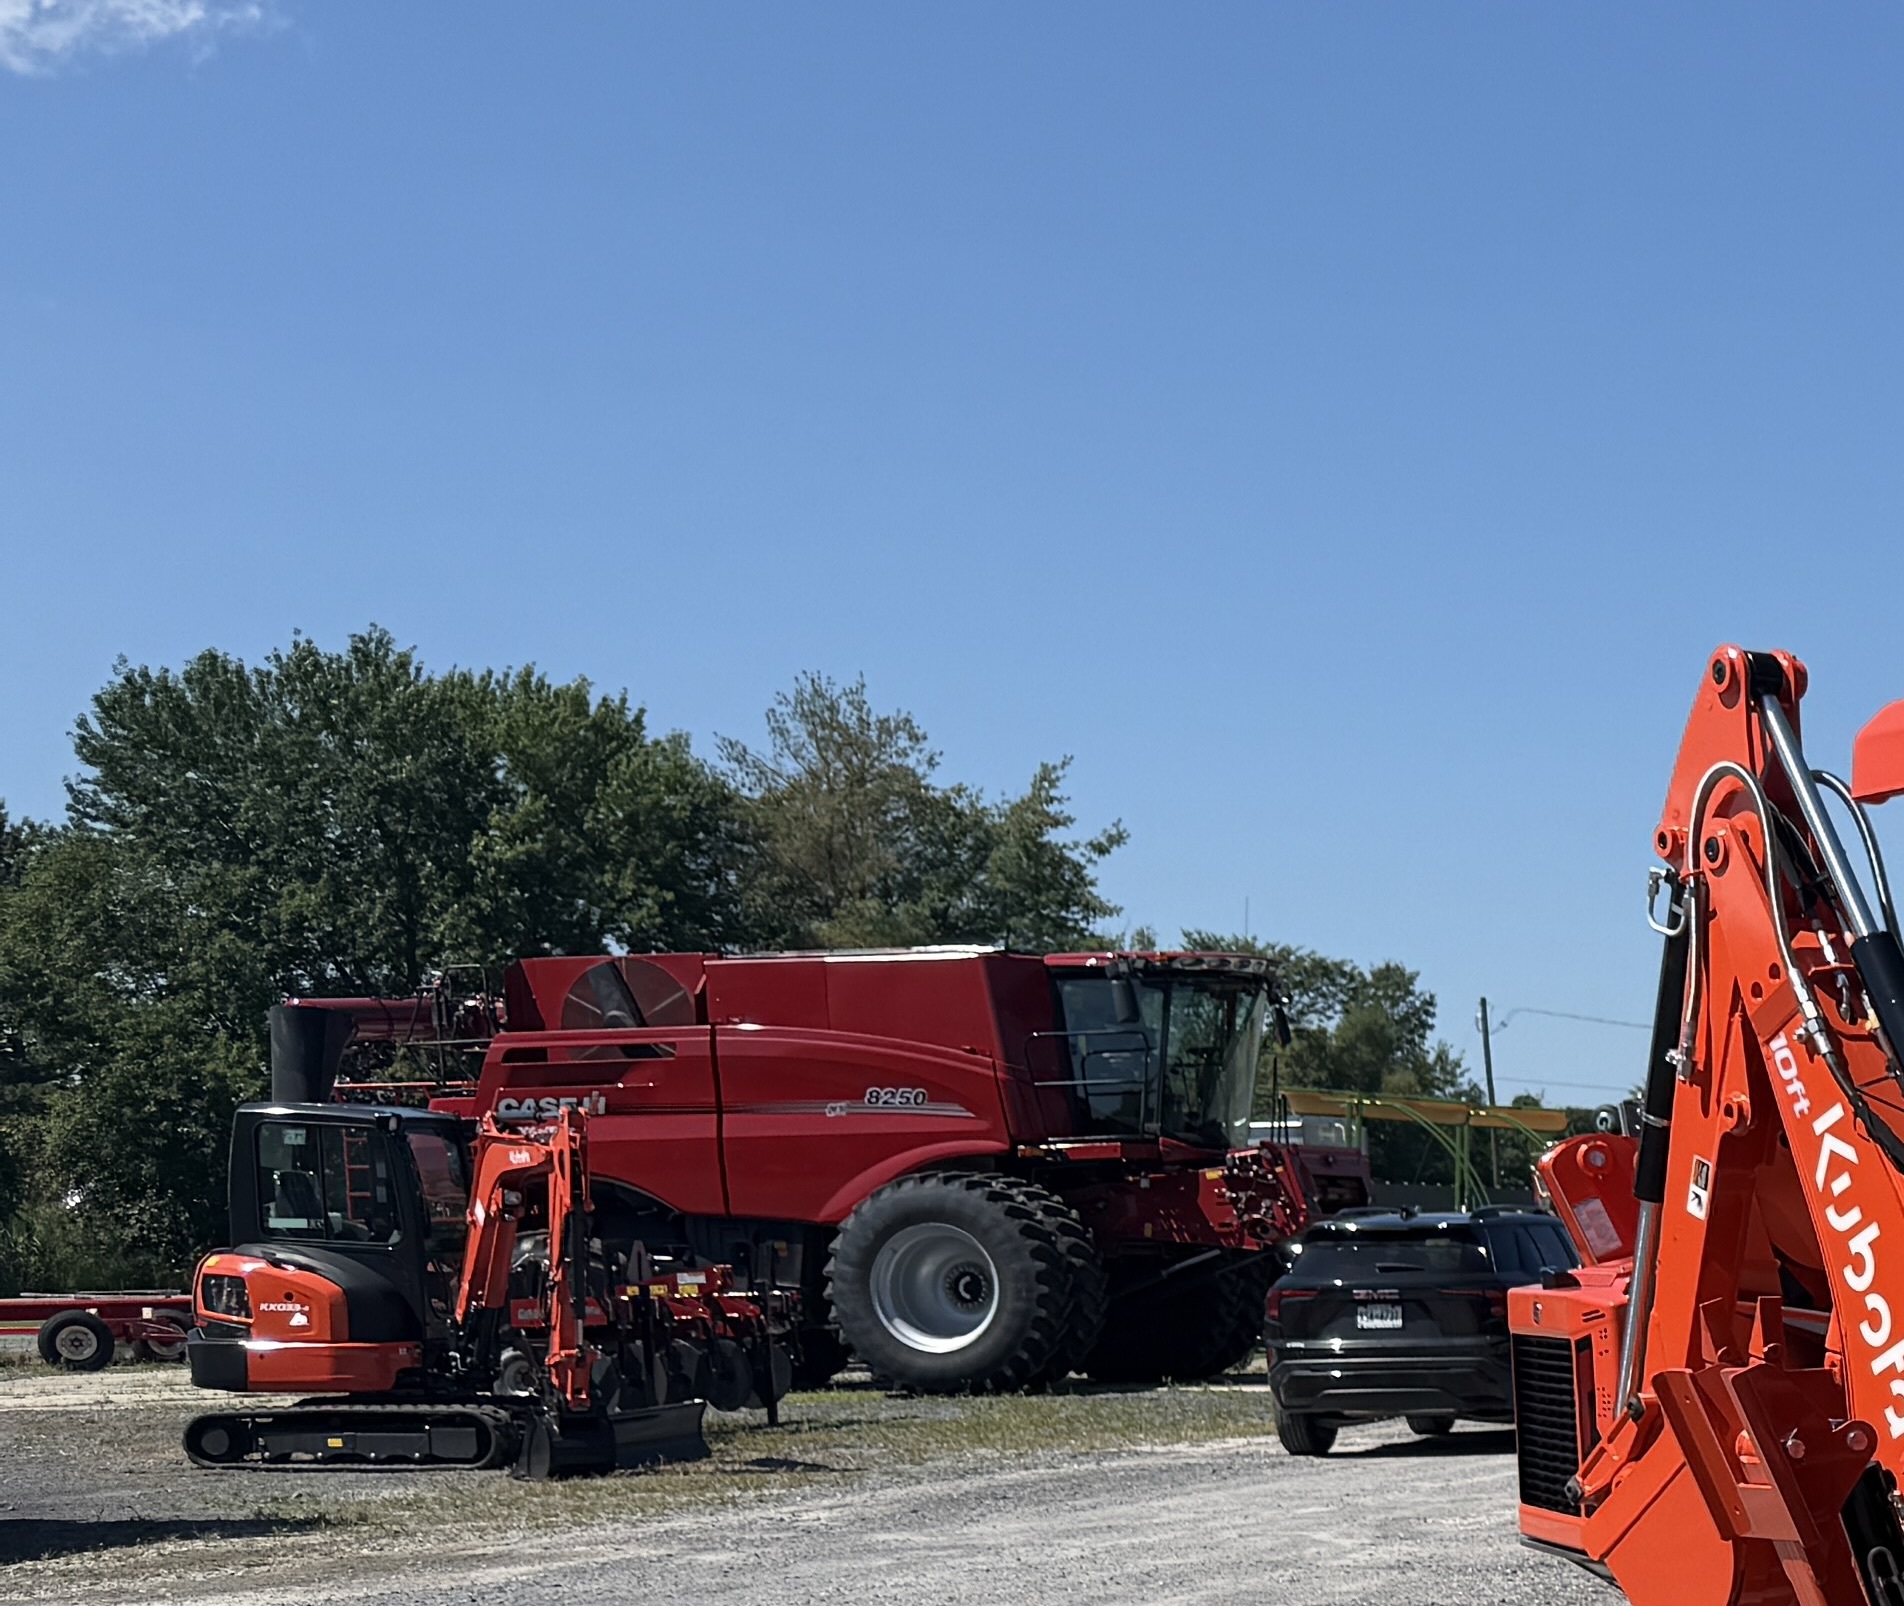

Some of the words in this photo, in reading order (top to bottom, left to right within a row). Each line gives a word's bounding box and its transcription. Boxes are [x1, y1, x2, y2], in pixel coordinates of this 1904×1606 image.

[1769, 1030, 1811, 1117] 10ft
[864, 1086, 929, 1107] 8250
[498, 1097, 578, 1120] CASE
